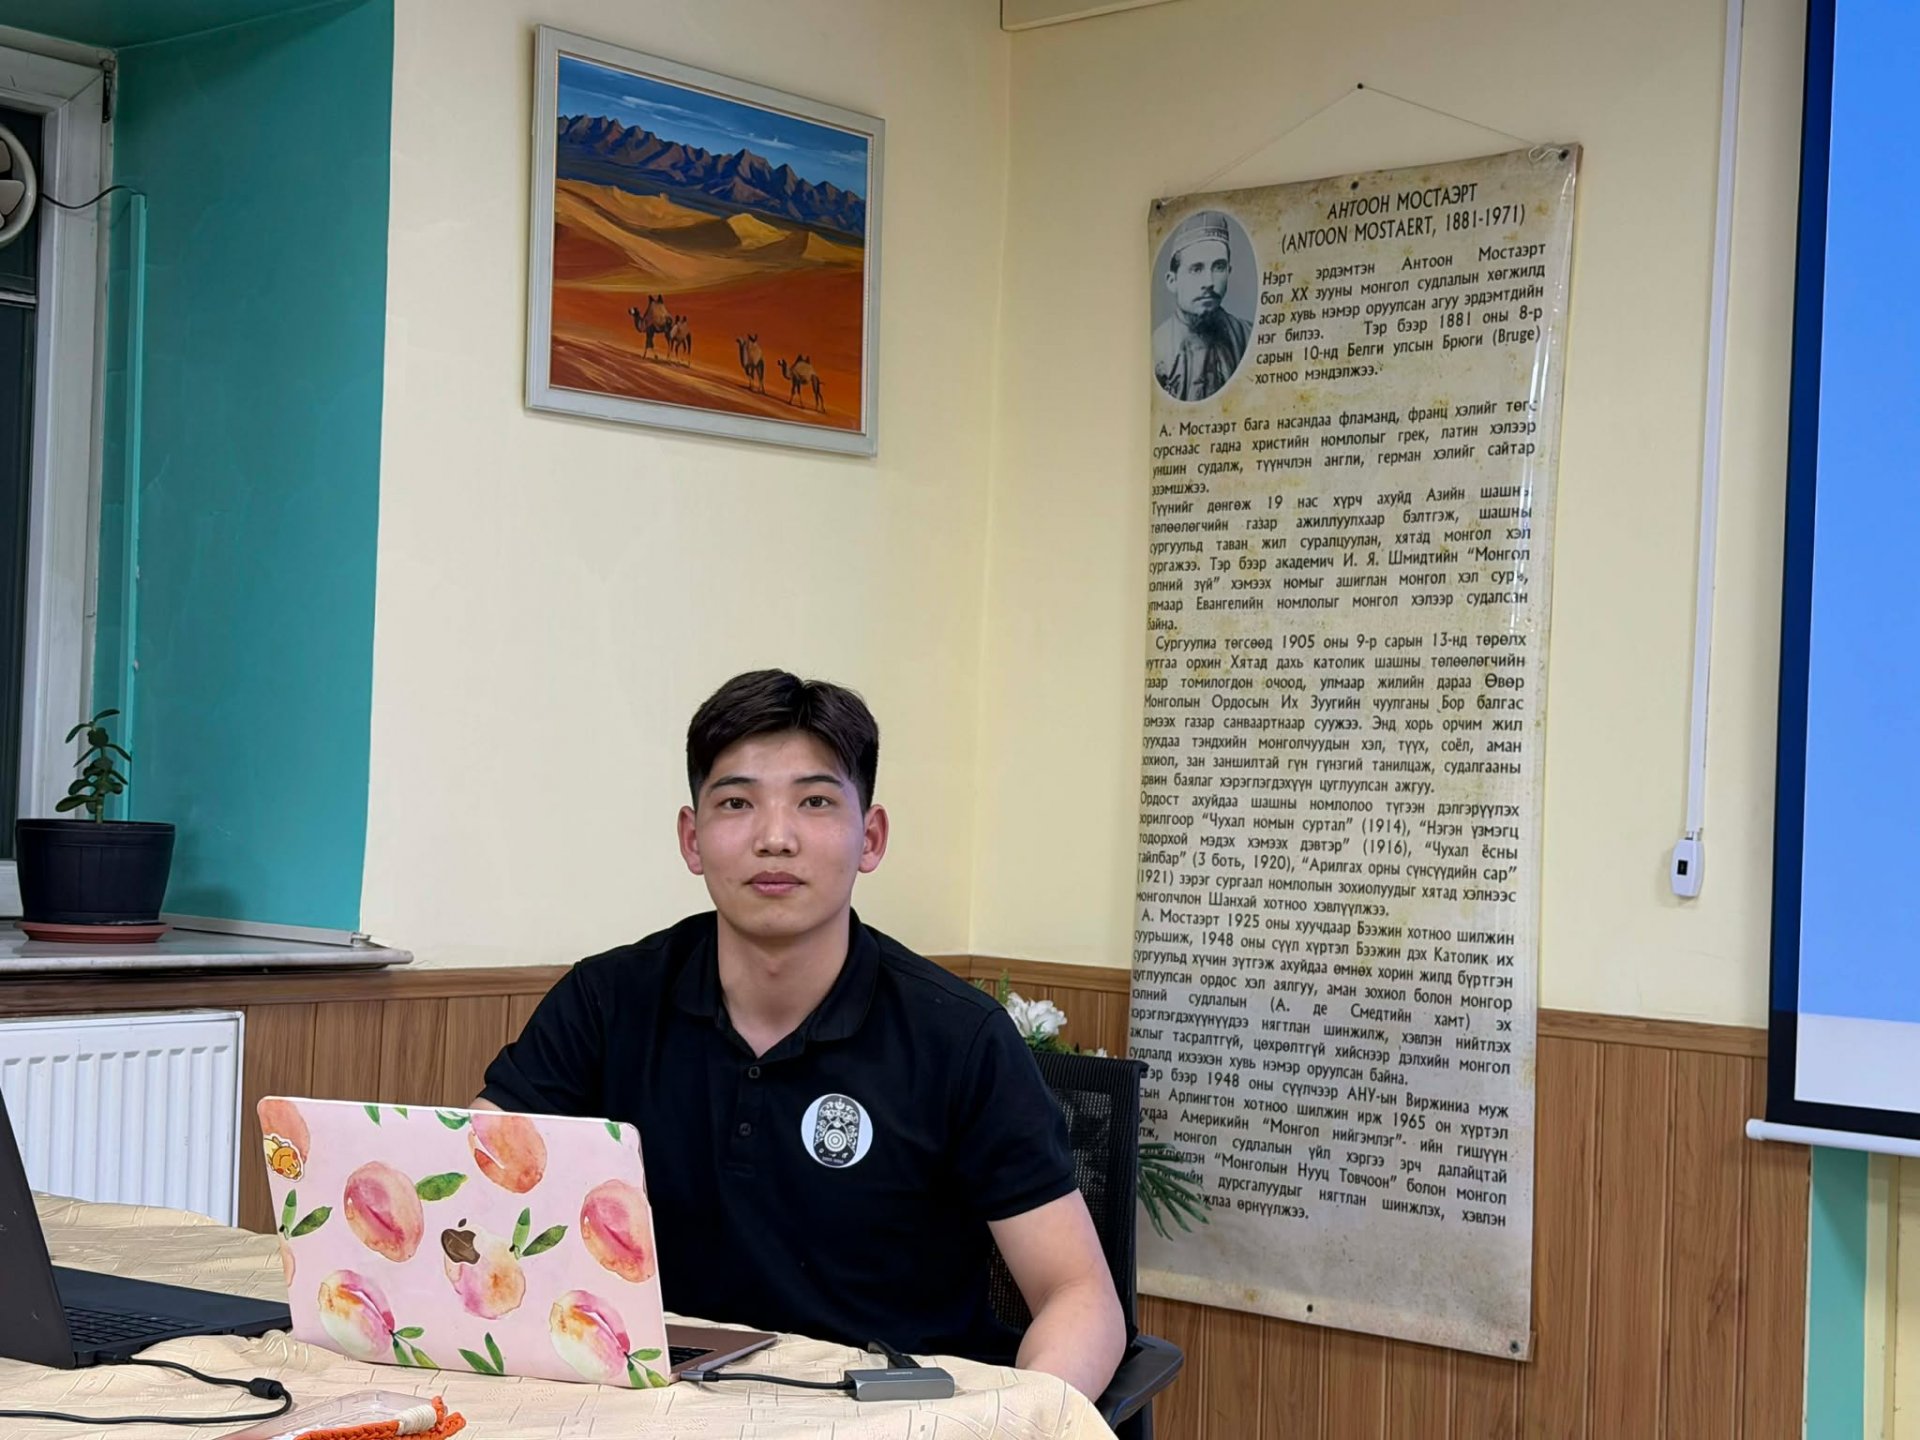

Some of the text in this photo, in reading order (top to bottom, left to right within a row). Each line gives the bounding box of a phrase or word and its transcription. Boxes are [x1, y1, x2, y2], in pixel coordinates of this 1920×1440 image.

[1326, 182, 1477, 219] АНТООН МОСТАЭРТ
[1281, 203, 1525, 254] (ANTOON MOSTAERT, 1881-1971)
[1315, 243, 1545, 281] эрдэмтэн Антоон Мостаэрт
[1260, 264, 1545, 305] бол зууны хөгжилд
[1258, 295, 1459, 326] асар хувь оруулсан агуу
[1363, 304, 1542, 337] Тэр бээр 1881 8-р
[1256, 334, 1483, 366] сарын Белги улсын Брюги
[1304, 365, 1379, 382] мэндэлжээ.
[1179, 406, 1447, 435] Мостаэрт бага фламанд, франц
[1210, 421, 1536, 454] гадна номлолыг латин хэлээр
[1256, 441, 1535, 472] түүнчлэн герман хэлийг сайтар
[1268, 486, 1465, 509] 19 нас хүрч Азийн
[1246, 508, 1459, 532] газар бэлтгэж,
[1215, 528, 1491, 551] таван жил монгол
[1209, 548, 1458, 573] Тэр бээр Шмидтийн
[1230, 573, 1446, 590] хэмээх номыг ашиглан монгол
[1196, 593, 1453, 610] Евангелийн монгол хэлээр
[1224, 631, 1467, 650] төгсөөд 1905 оны сарын 13-нд
[1186, 655, 1365, 671] орхин Хятад дахь католик
[1180, 675, 1471, 692] томилогдон улмаар жилийн дараа
[1211, 693, 1524, 712] Ордосын Их чуулганы балгас
[1184, 715, 1523, 733] газар Энд хорь жил
[1191, 735, 1521, 754] тэндхийн хэл, түүх, аман
[1186, 755, 1521, 775] зан заншилтай гүн судалгааны
[1173, 772, 1388, 794] баялаг цуглуулсан
[1191, 793, 1373, 812] ахуйдаа номлолоо
[1253, 817, 1519, 840] номын үзмэгц
[1199, 835, 1518, 859] мэдэх хэмээх ёсны
[1211, 852, 1477, 880] боть, орны сүнсүүдийн
[1179, 874, 1457, 901] зэрэг сургаал номлолын хятад
[1208, 891, 1307, 911] Шанхай хотноо
[1228, 912, 1514, 945] 1925 оны Бээжин шилжин
[1202, 931, 1488, 965] 1948 оны Бээжин дэх Католик
[1191, 953, 1452, 986] хүчин ахуйдаа хорин жилд
[1188, 993, 1411, 1023] судлалын де Смедтийн
[1244, 977, 1512, 1013] хэл аман зохиол монгор
[1261, 1019, 1511, 1053] нягтлан шинжилж, нийтлэх
[1178, 1051, 1363, 1080] ихээхэн хувь оруулсан
[1334, 1045, 1510, 1075] хийснээр монгол
[1208, 1071, 1508, 1119] 1948 оны АНУ-ын муж
[1243, 1098, 1451, 1133] хотноо ирж 1965 он
[1179, 1109, 1507, 1163] Америкийн гишүүн
[1173, 1131, 1507, 1183] монгол хэргээ эрч далайцтай
[1297, 1161, 1506, 1205] Нууц болон монгол
[1319, 1189, 1506, 1227] нягтлан шинжлэх, хэвлэн
